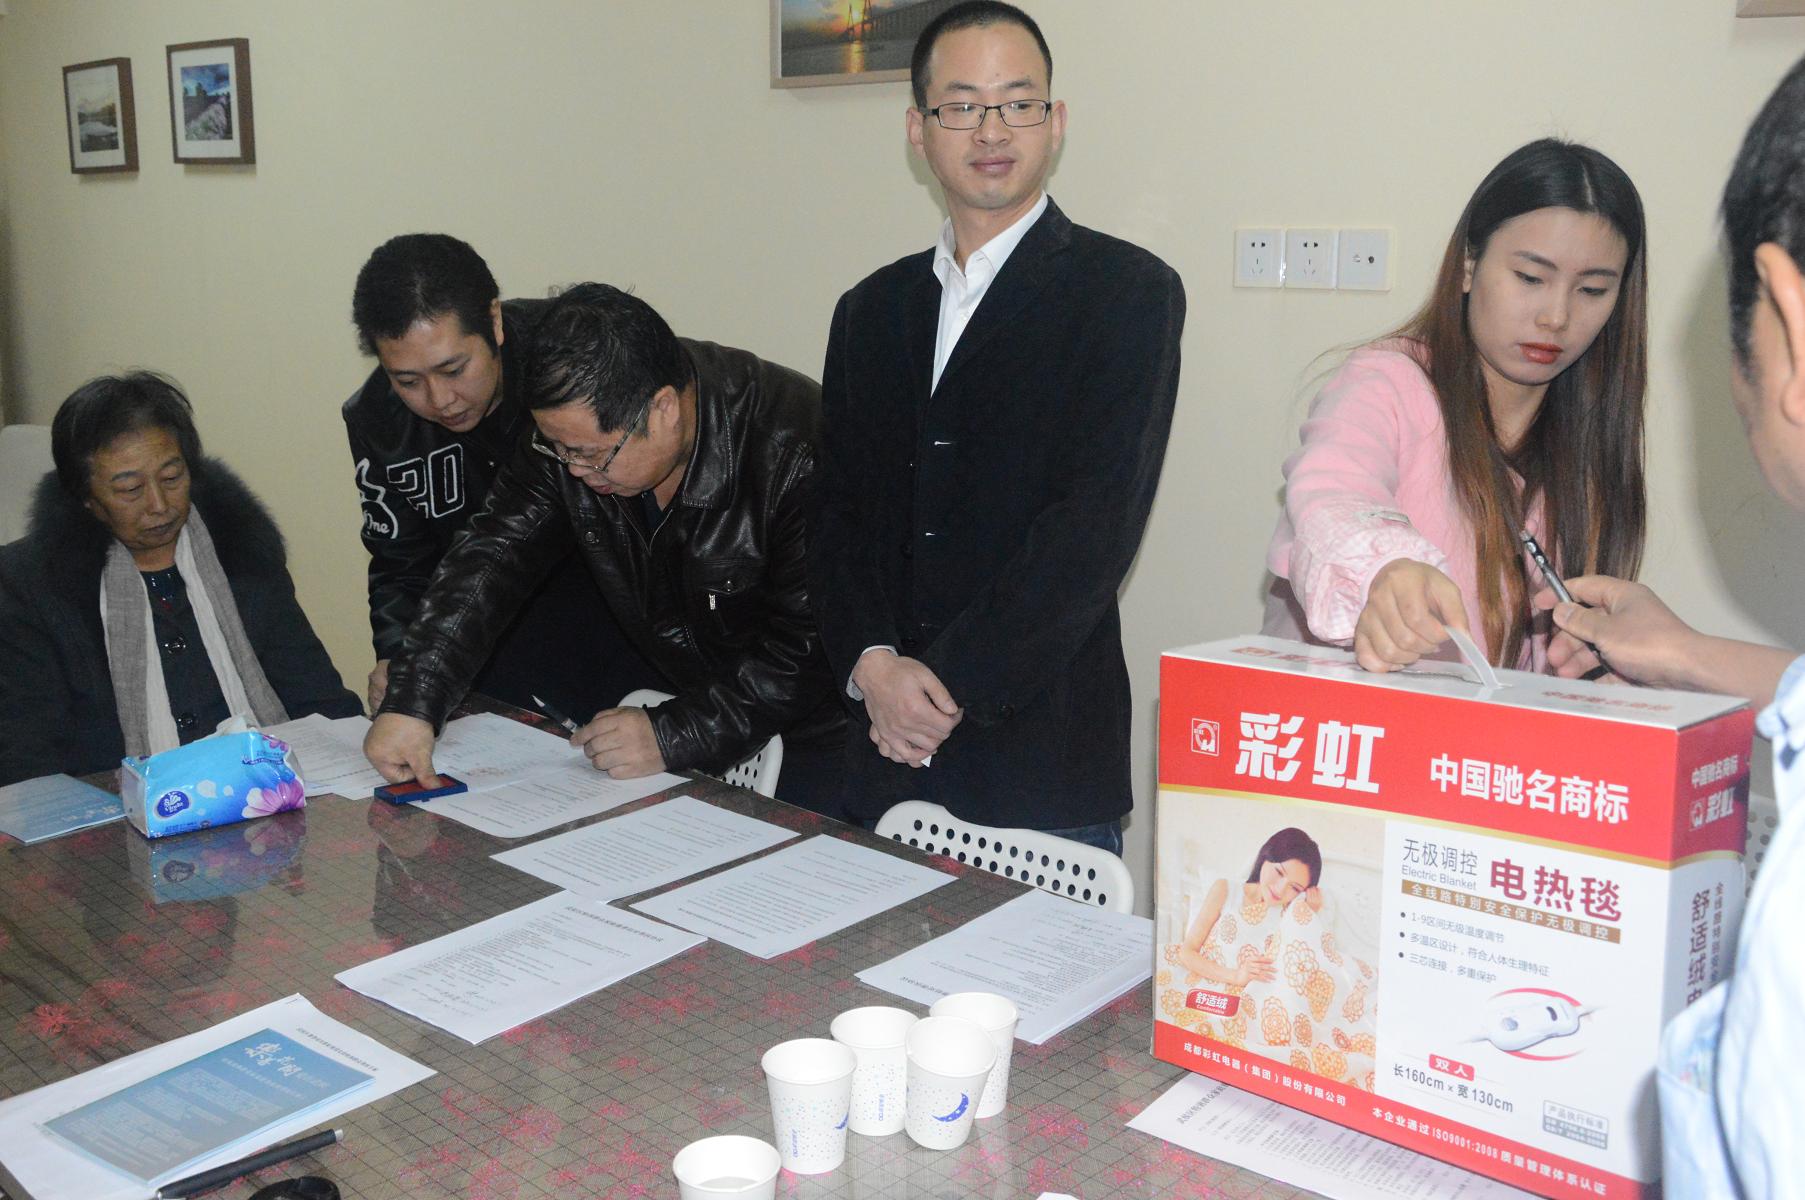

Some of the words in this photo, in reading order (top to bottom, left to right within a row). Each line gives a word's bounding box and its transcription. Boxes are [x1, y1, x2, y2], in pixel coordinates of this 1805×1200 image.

[1235, 711, 1386, 794] 彩虹
[1430, 753, 1629, 825] 中国驰名商标
[1401, 864, 1438, 884] Electric
[1439, 873, 1477, 892] Blanket
[1402, 837, 1479, 877] 无极调控
[1490, 857, 1622, 922] 电热毯
[1435, 1057, 1469, 1078] 双人
